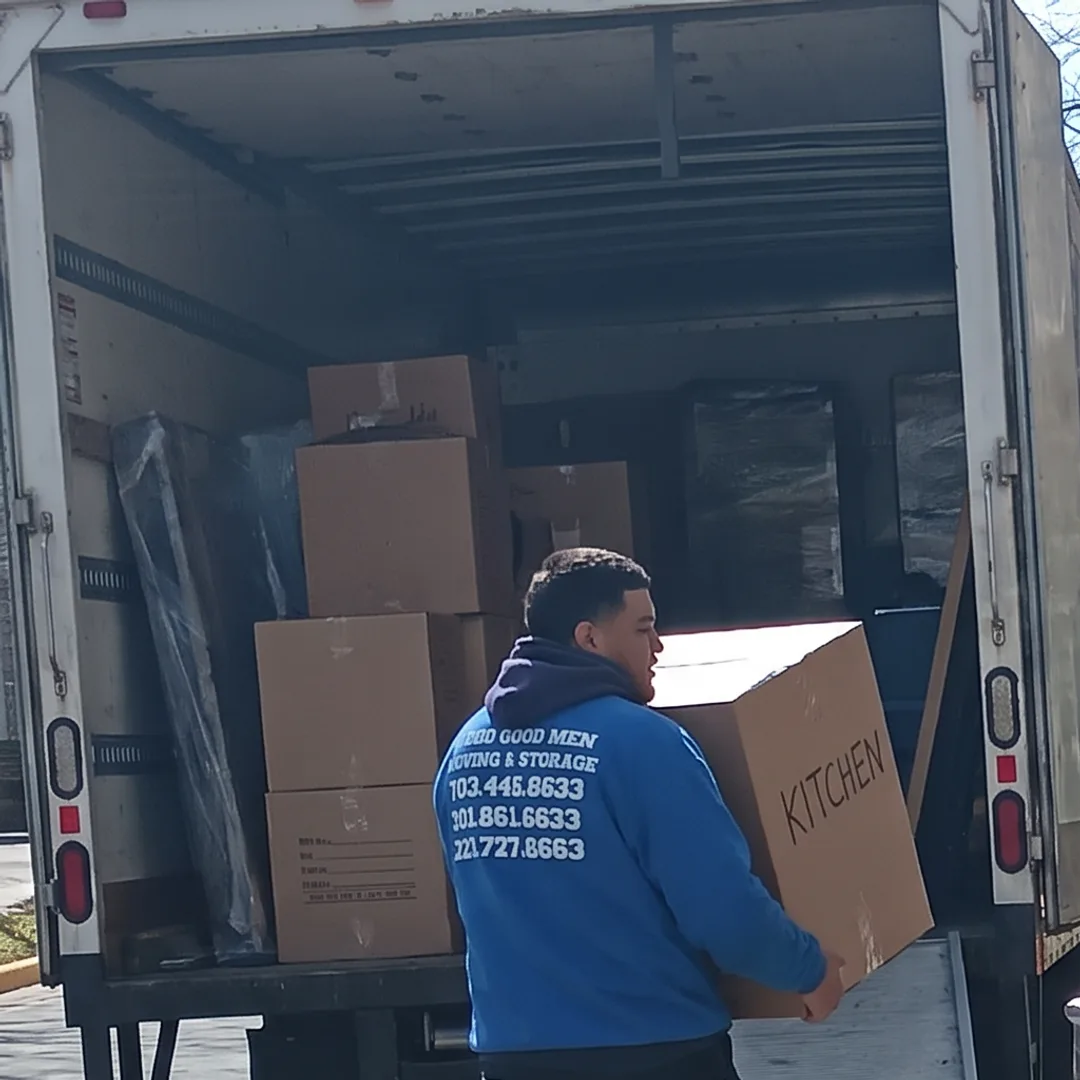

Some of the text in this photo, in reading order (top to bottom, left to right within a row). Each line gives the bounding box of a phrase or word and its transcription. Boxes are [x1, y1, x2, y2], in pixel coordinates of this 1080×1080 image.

[499, 728, 545, 745] GOOD
[548, 728, 599, 749] MEN
[504, 751, 514, 768] &
[518, 751, 599, 773] STORAGE
[780, 729, 884, 846] KITCHEN
